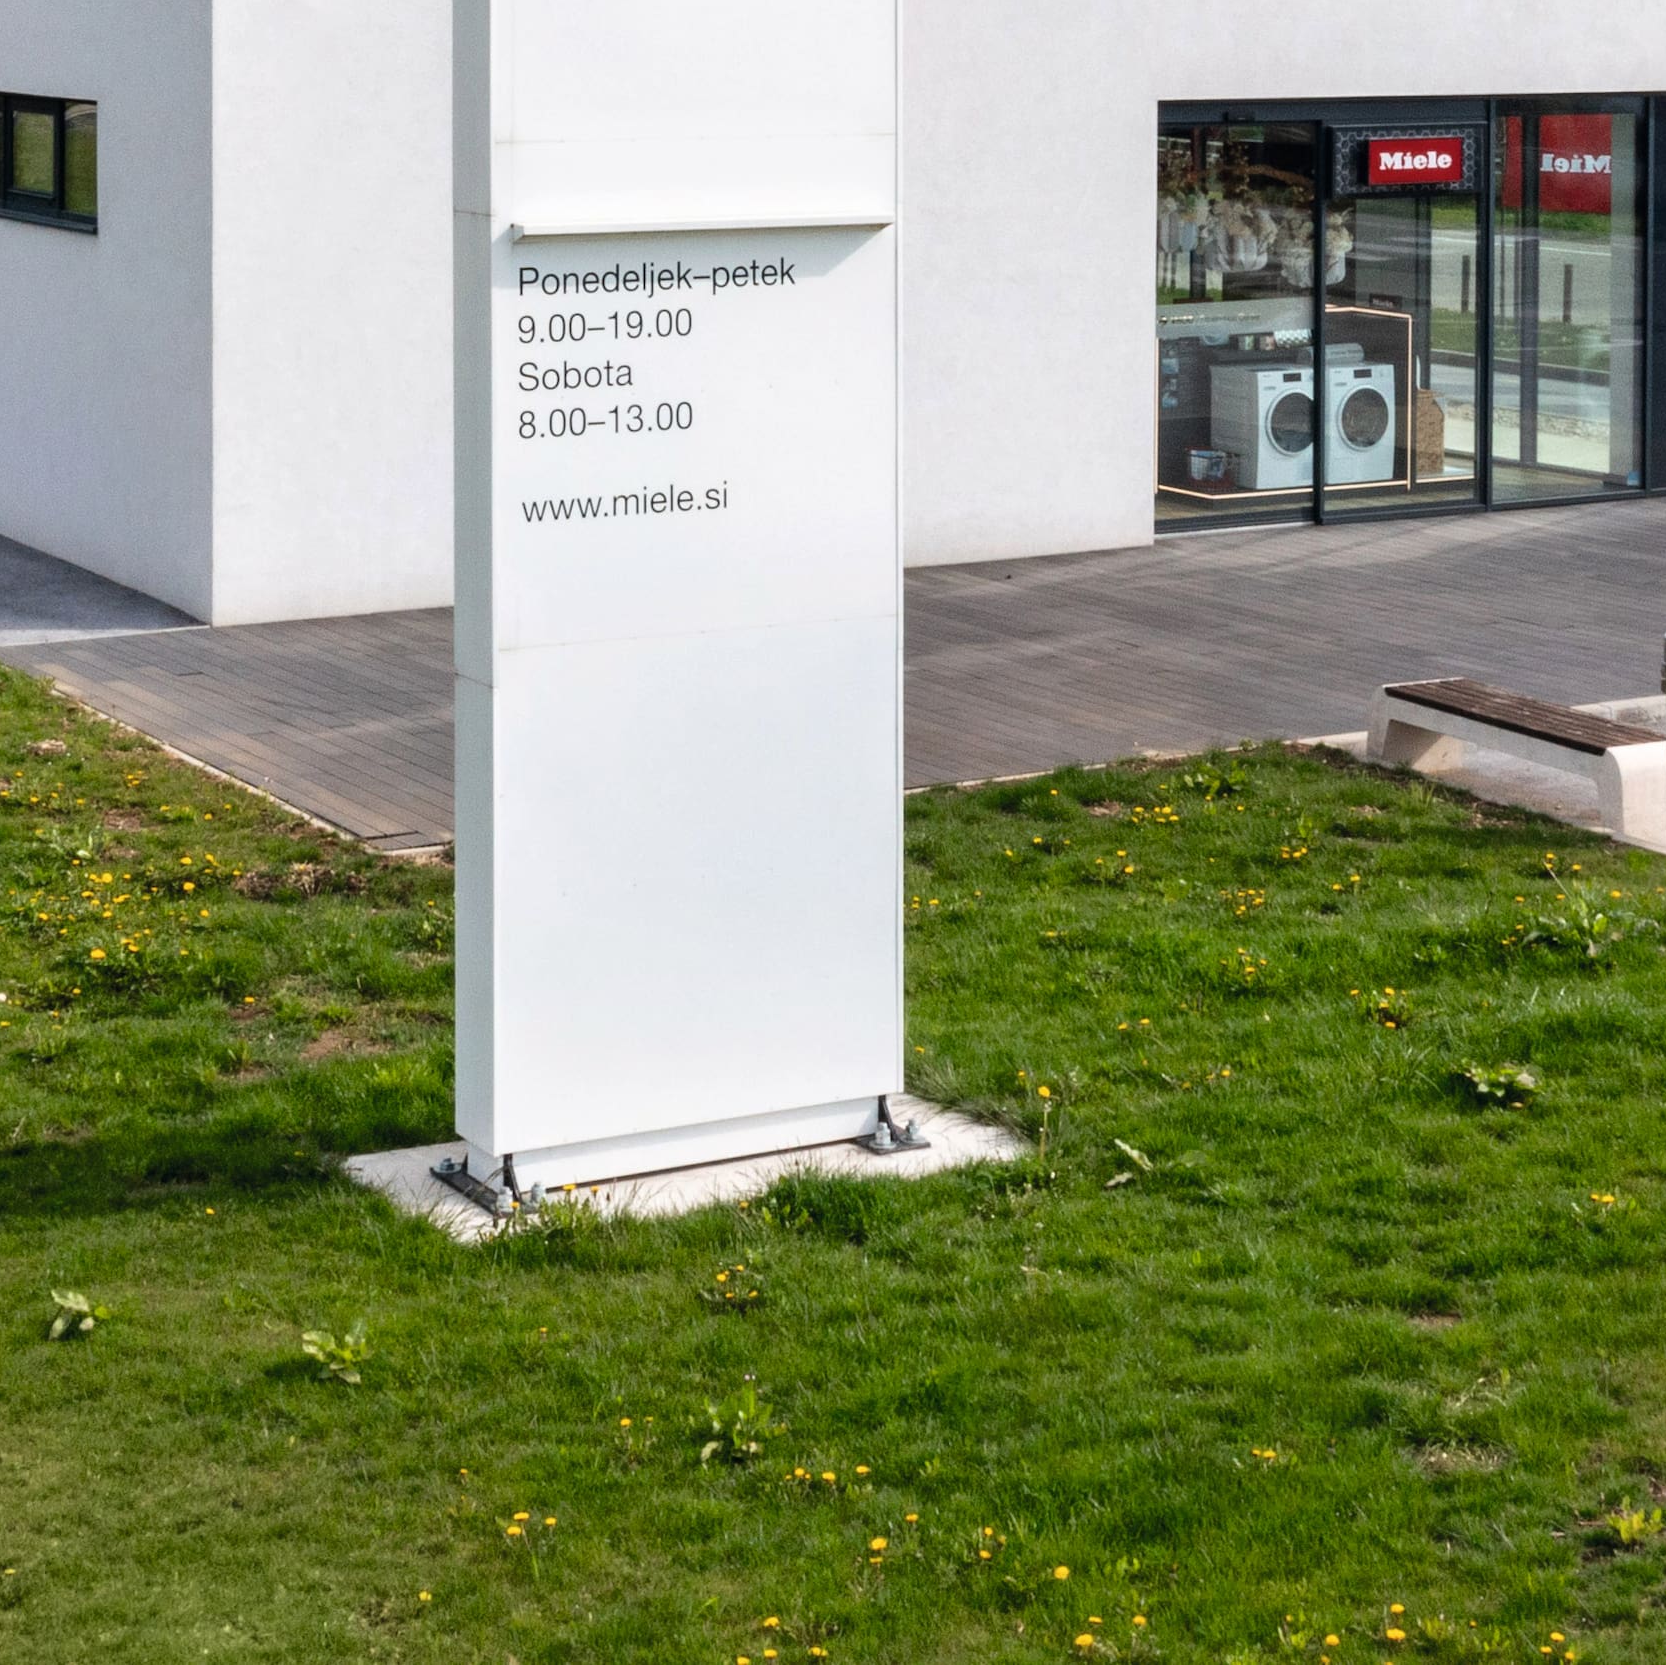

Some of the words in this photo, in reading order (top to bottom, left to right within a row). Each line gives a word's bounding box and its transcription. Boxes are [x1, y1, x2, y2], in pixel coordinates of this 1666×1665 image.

[1379, 150, 1453, 171] Miele
[519, 257, 796, 298] Ponedeljek–petek
[518, 308, 692, 344] 9.00–19.00
[518, 360, 633, 392] Sobota
[518, 401, 693, 439] 8.00–13.00
[522, 480, 728, 523] www.miele.si
